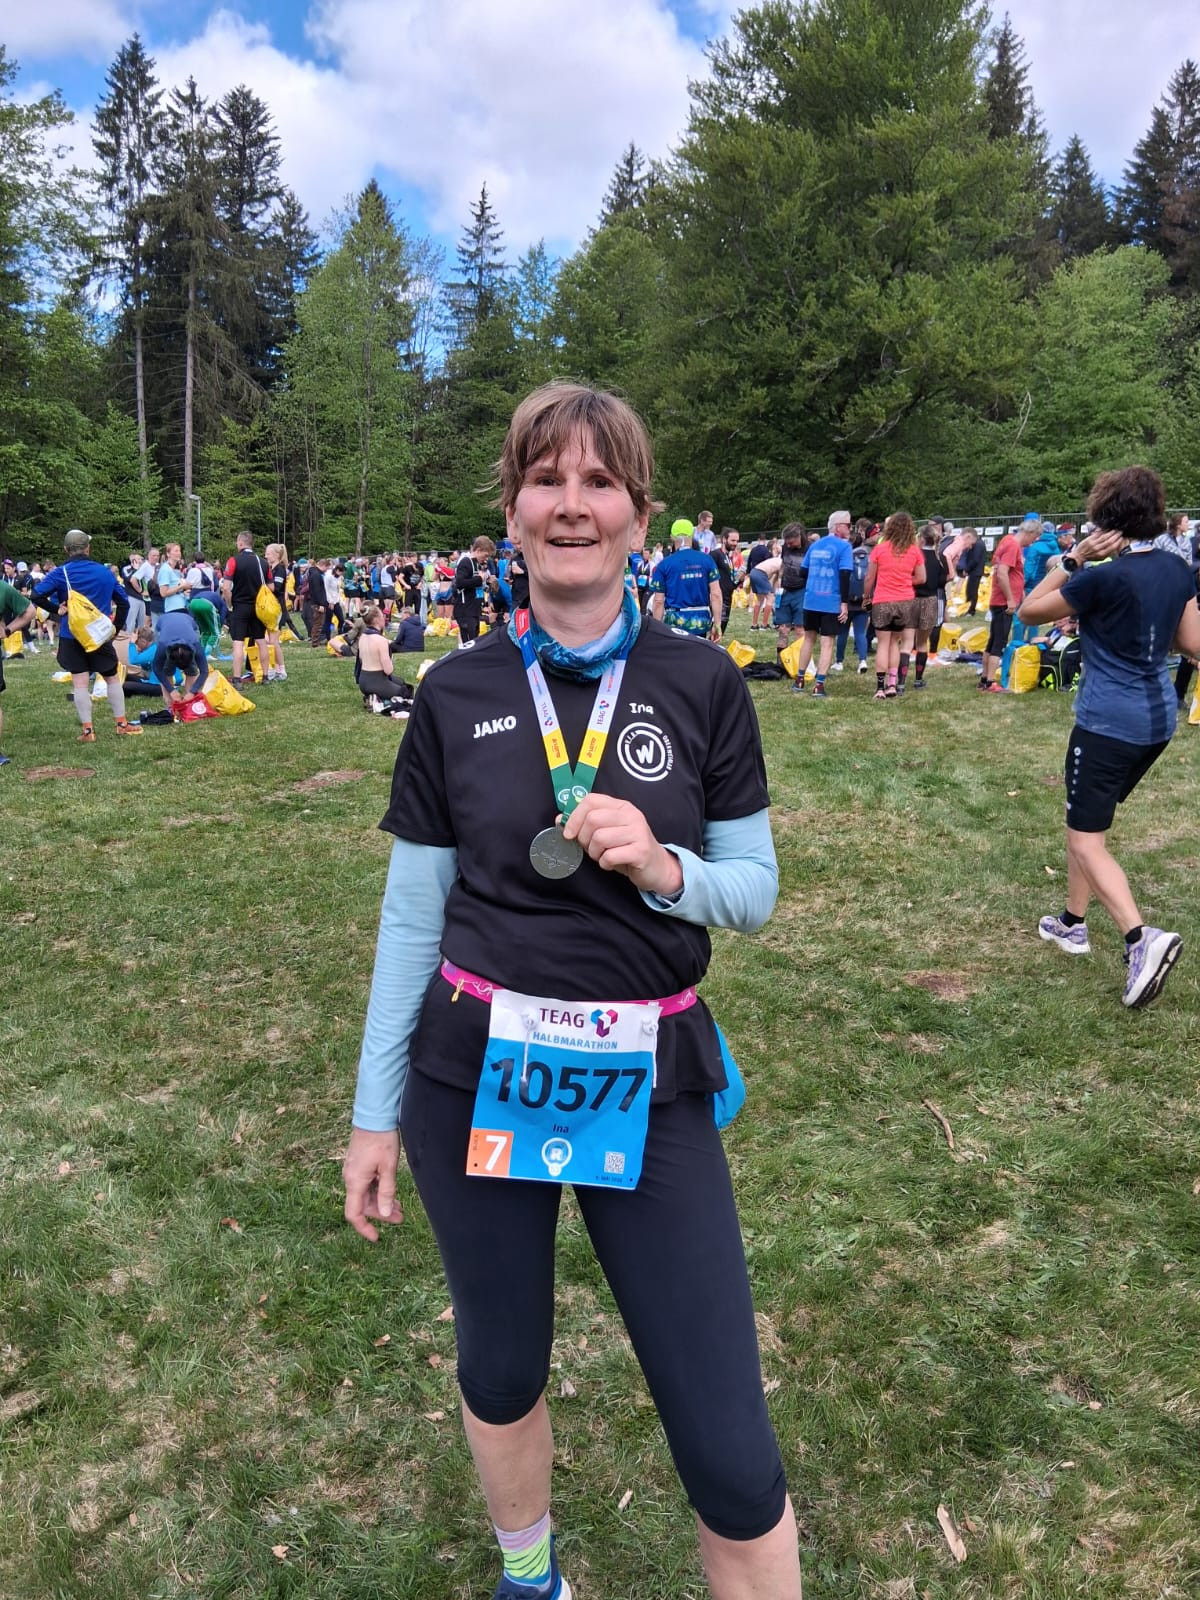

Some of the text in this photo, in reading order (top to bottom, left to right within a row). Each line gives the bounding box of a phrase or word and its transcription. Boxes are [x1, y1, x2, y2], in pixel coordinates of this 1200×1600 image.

[597, 710, 605, 725] TEAG
[629, 702, 654, 715] Ina
[473, 715, 517, 739] JAKO
[635, 740, 655, 764] W
[539, 1008, 585, 1028] TEAG
[532, 1031, 618, 1050] HALBMARATHON
[490, 1057, 648, 1113] 10577
[552, 1123, 569, 1134] Ina
[485, 1134, 507, 1172] 7
